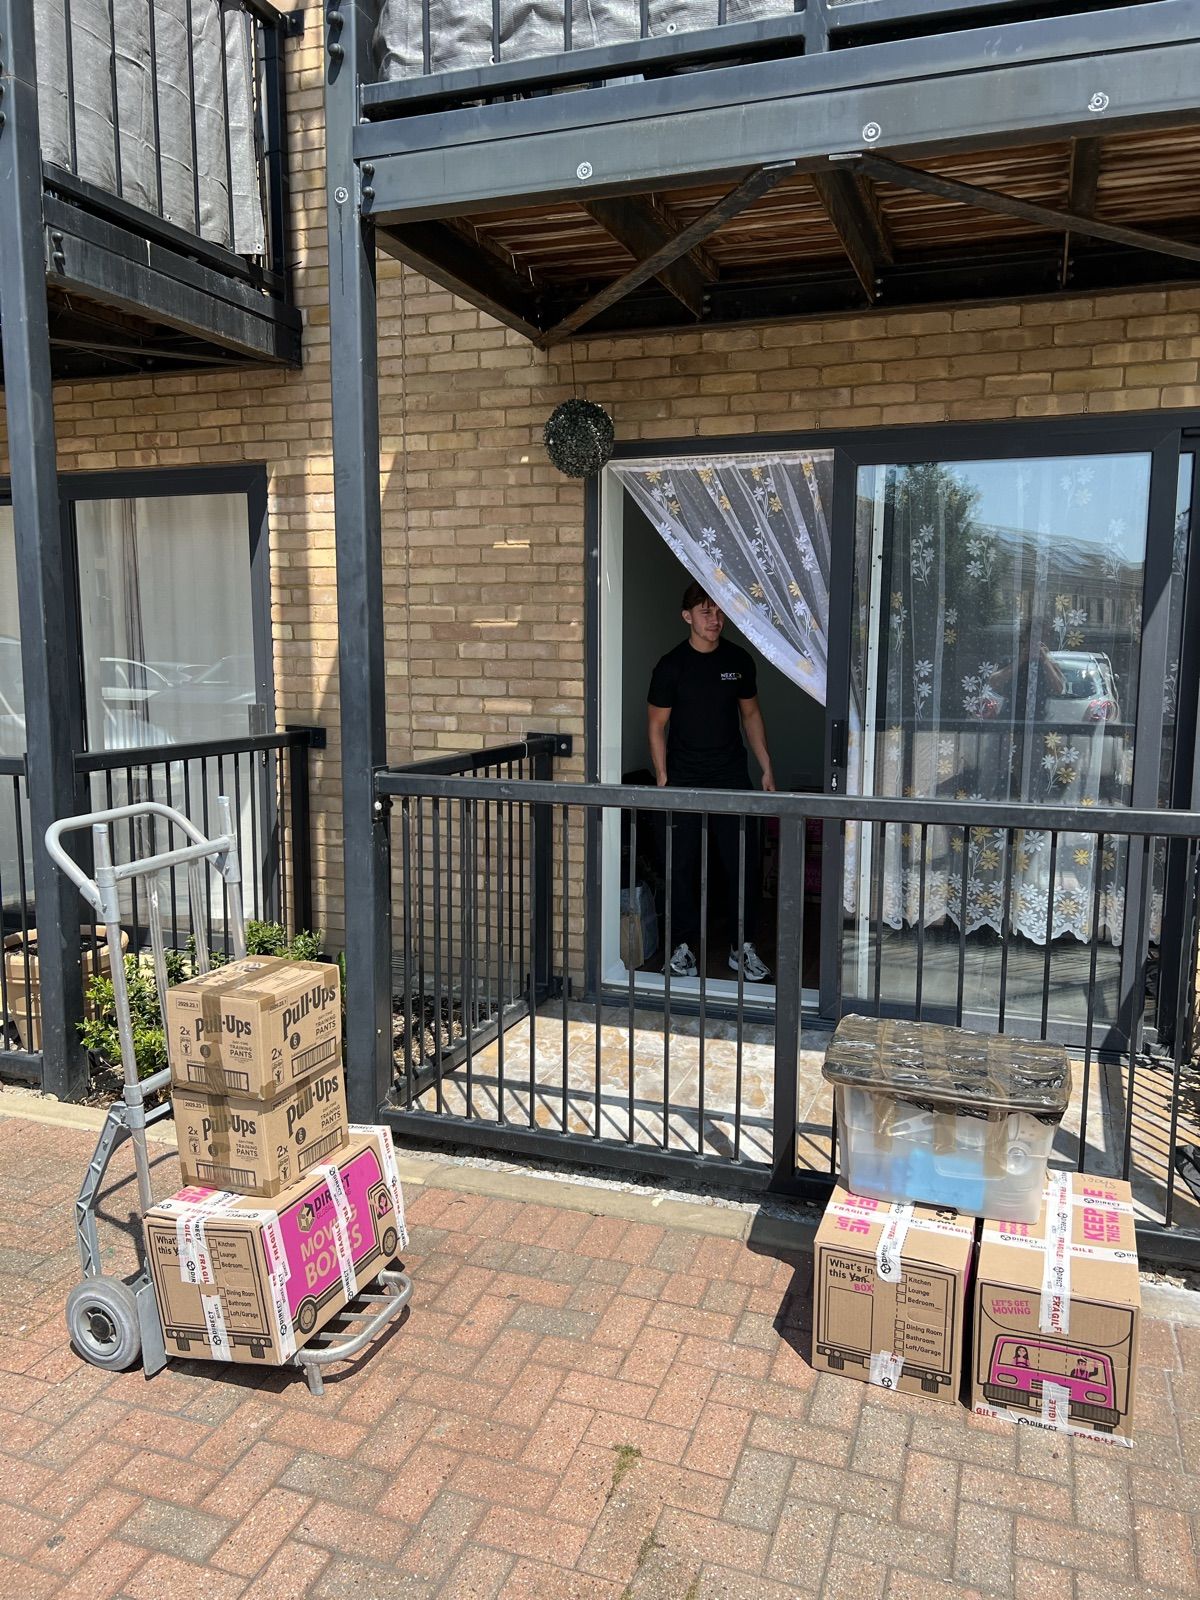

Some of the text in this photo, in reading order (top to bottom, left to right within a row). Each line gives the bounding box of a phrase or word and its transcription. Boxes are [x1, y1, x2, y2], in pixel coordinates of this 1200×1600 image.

[180, 1026, 191, 1036] 2x
[316, 1020, 336, 1036] PANTS
[230, 1050, 252, 1058] PANTS
[272, 1048, 282, 1060] 2x
[321, 1110, 341, 1128] PANTS
[188, 1126, 198, 1136] 2x
[236, 1148, 258, 1156] PANTS
[277, 1146, 288, 1158] 2x
[314, 1174, 350, 1212] DIRT
[834, 1206, 870, 1216] FRAGILE
[1105, 1191, 1120, 1242] THIS WA P!
[1084, 1207, 1104, 1242] KEEP
[184, 1218, 192, 1244] AGILE
[300, 1204, 358, 1262] MOVG
[156, 1236, 177, 1245] What'
[268, 1222, 280, 1260] FRAGILE
[334, 1222, 345, 1258] FRAGILE
[1012, 1236, 1038, 1244] DIRECT
[158, 1248, 172, 1256] this
[220, 1251, 237, 1259] Lounge
[1072, 1246, 1094, 1254] GILE
[304, 1224, 362, 1289] BOXS
[830, 1258, 874, 1274] What's in
[829, 1269, 846, 1280] this
[908, 1276, 932, 1286] Kitchen
[226, 1289, 242, 1298] Dining
[908, 1286, 930, 1296] Lounge
[908, 1296, 934, 1308] Bedroom
[230, 1310, 258, 1318] Loft/Garage
[993, 1306, 1031, 1315] MOVING
[208, 1311, 217, 1335] DIRECT
[906, 1324, 942, 1337] Dining Room
[906, 1334, 936, 1344] Bathroom
[906, 1344, 942, 1356] Loft/Garage
[1048, 1399, 1056, 1418] GILE
[976, 1407, 998, 1418] GILE
[1030, 1420, 1058, 1432] DIRECT
